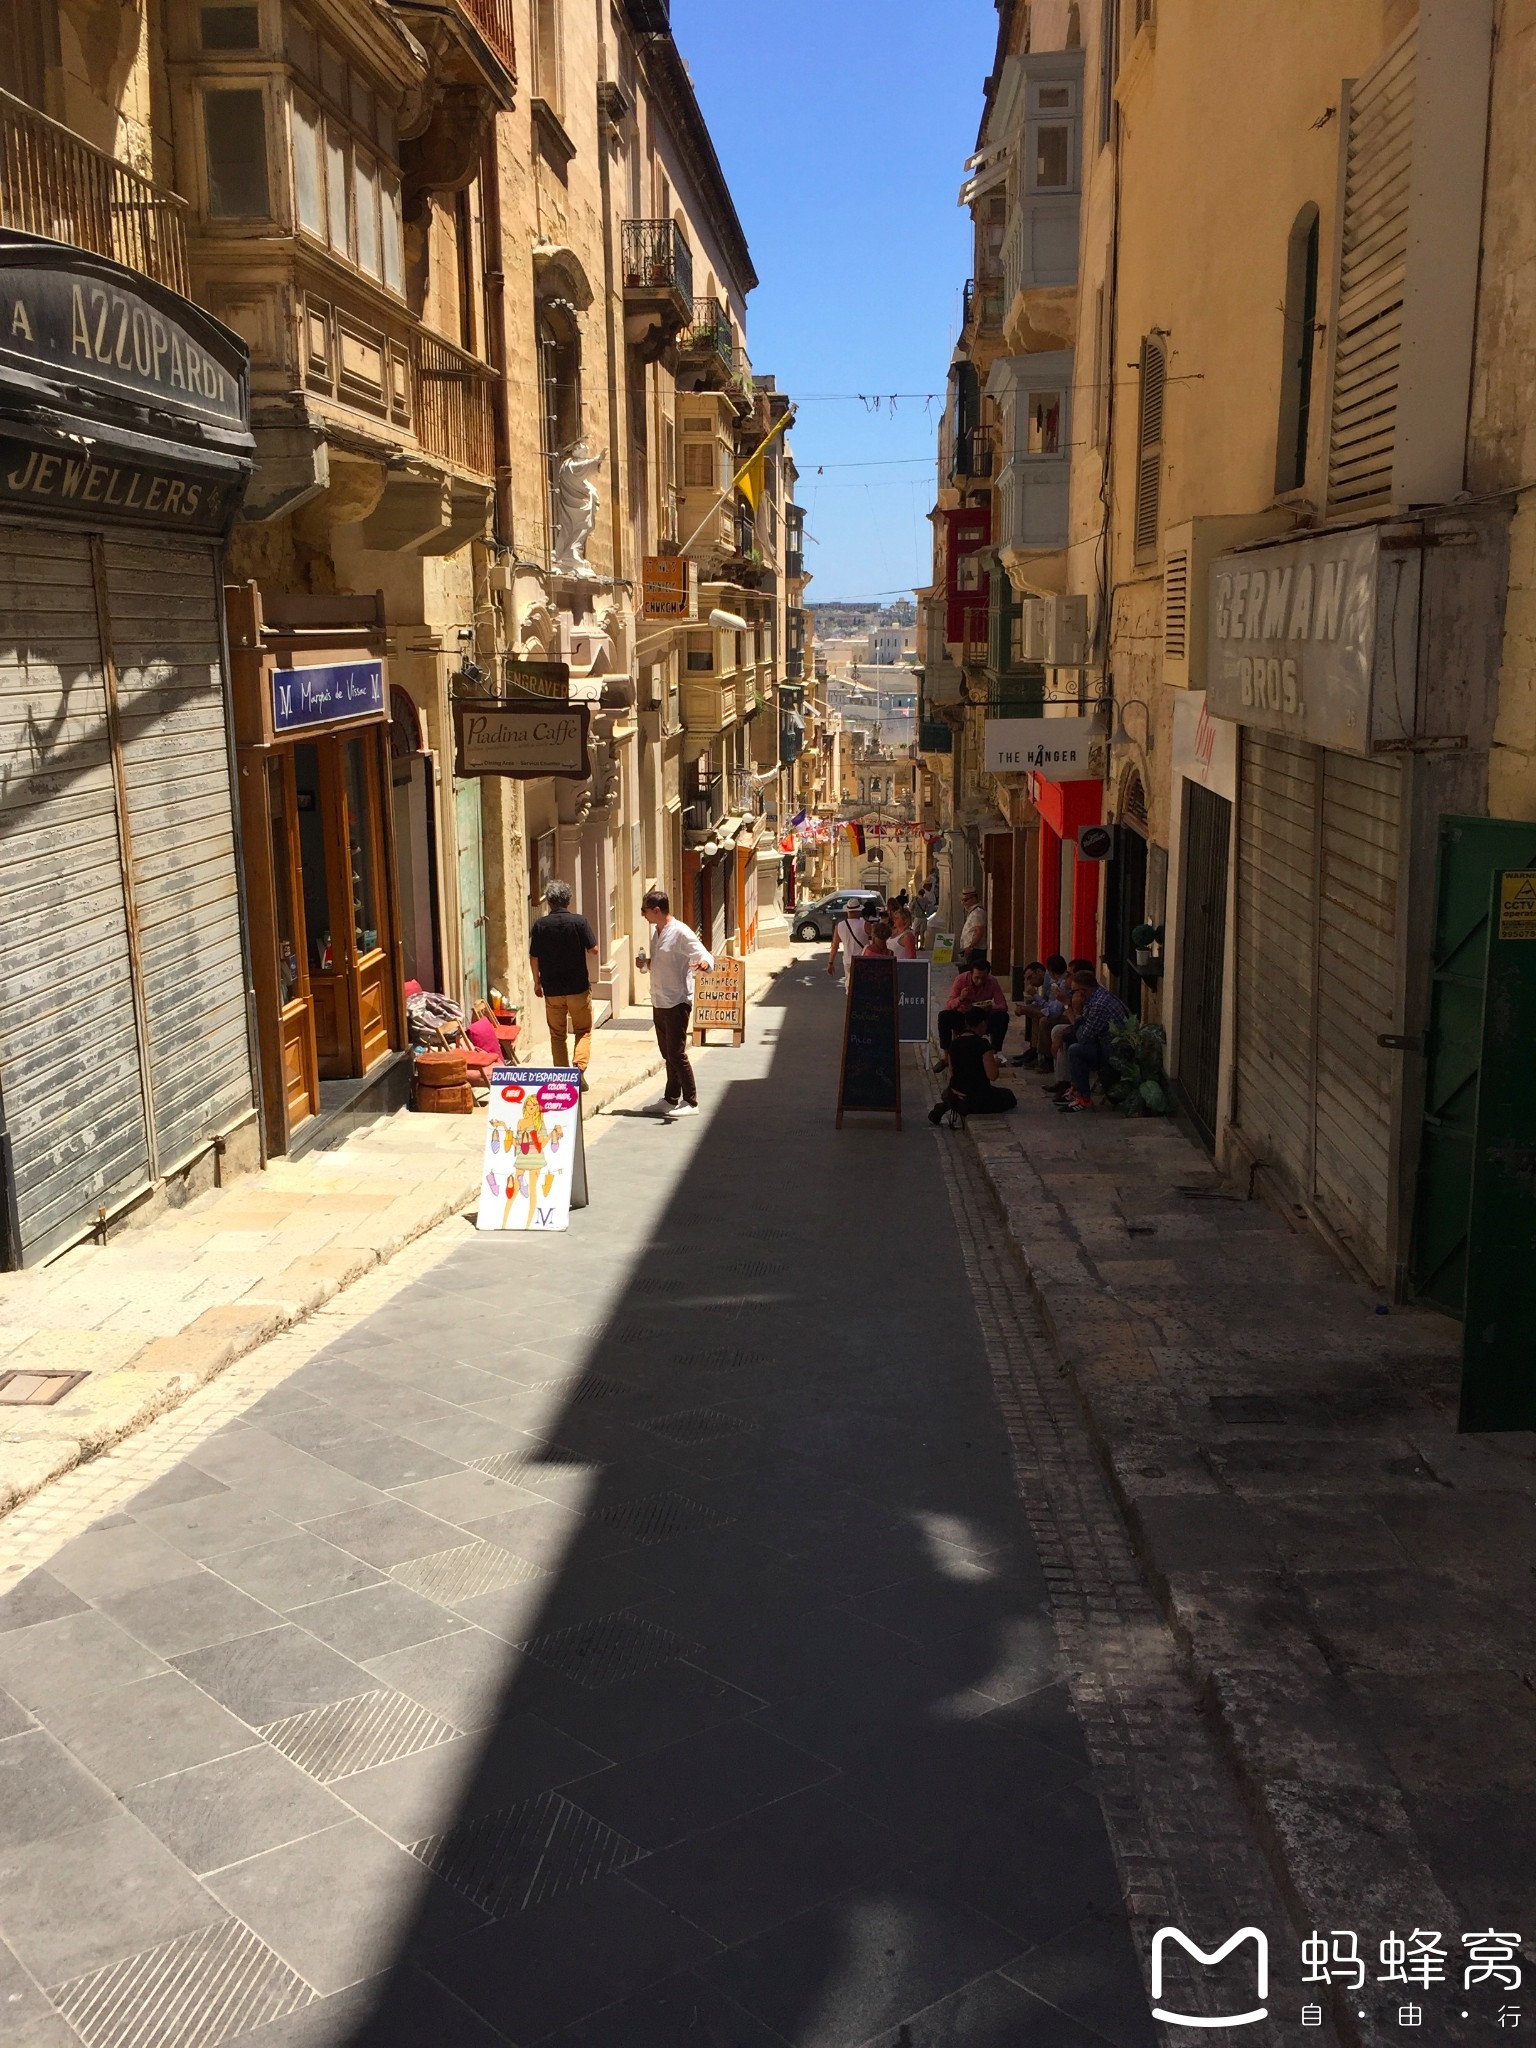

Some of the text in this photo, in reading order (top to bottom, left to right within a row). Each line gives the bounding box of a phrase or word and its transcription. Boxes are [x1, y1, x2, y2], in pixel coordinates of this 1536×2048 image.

[72, 284, 225, 402] AZZOPARDI
[7, 452, 201, 517] JEWELLERS
[507, 670, 568, 698] ENGRAVER
[301, 681, 331, 714] Marquis
[335, 681, 343, 700] de
[468, 716, 527, 745] Piadina
[998, 744, 1077, 767] THE HANGER
[1504, 901, 1535, 910] CCTV
[1503, 911, 1536, 919] operat
[698, 991, 739, 1001] CHURCH
[898, 991, 925, 1006] ANGER
[698, 1009, 737, 1022] WELCOME
[492, 1071, 579, 1083] BOUTIQUE D'ESPADRILLES
[505, 1089, 521, 1098] NEW
